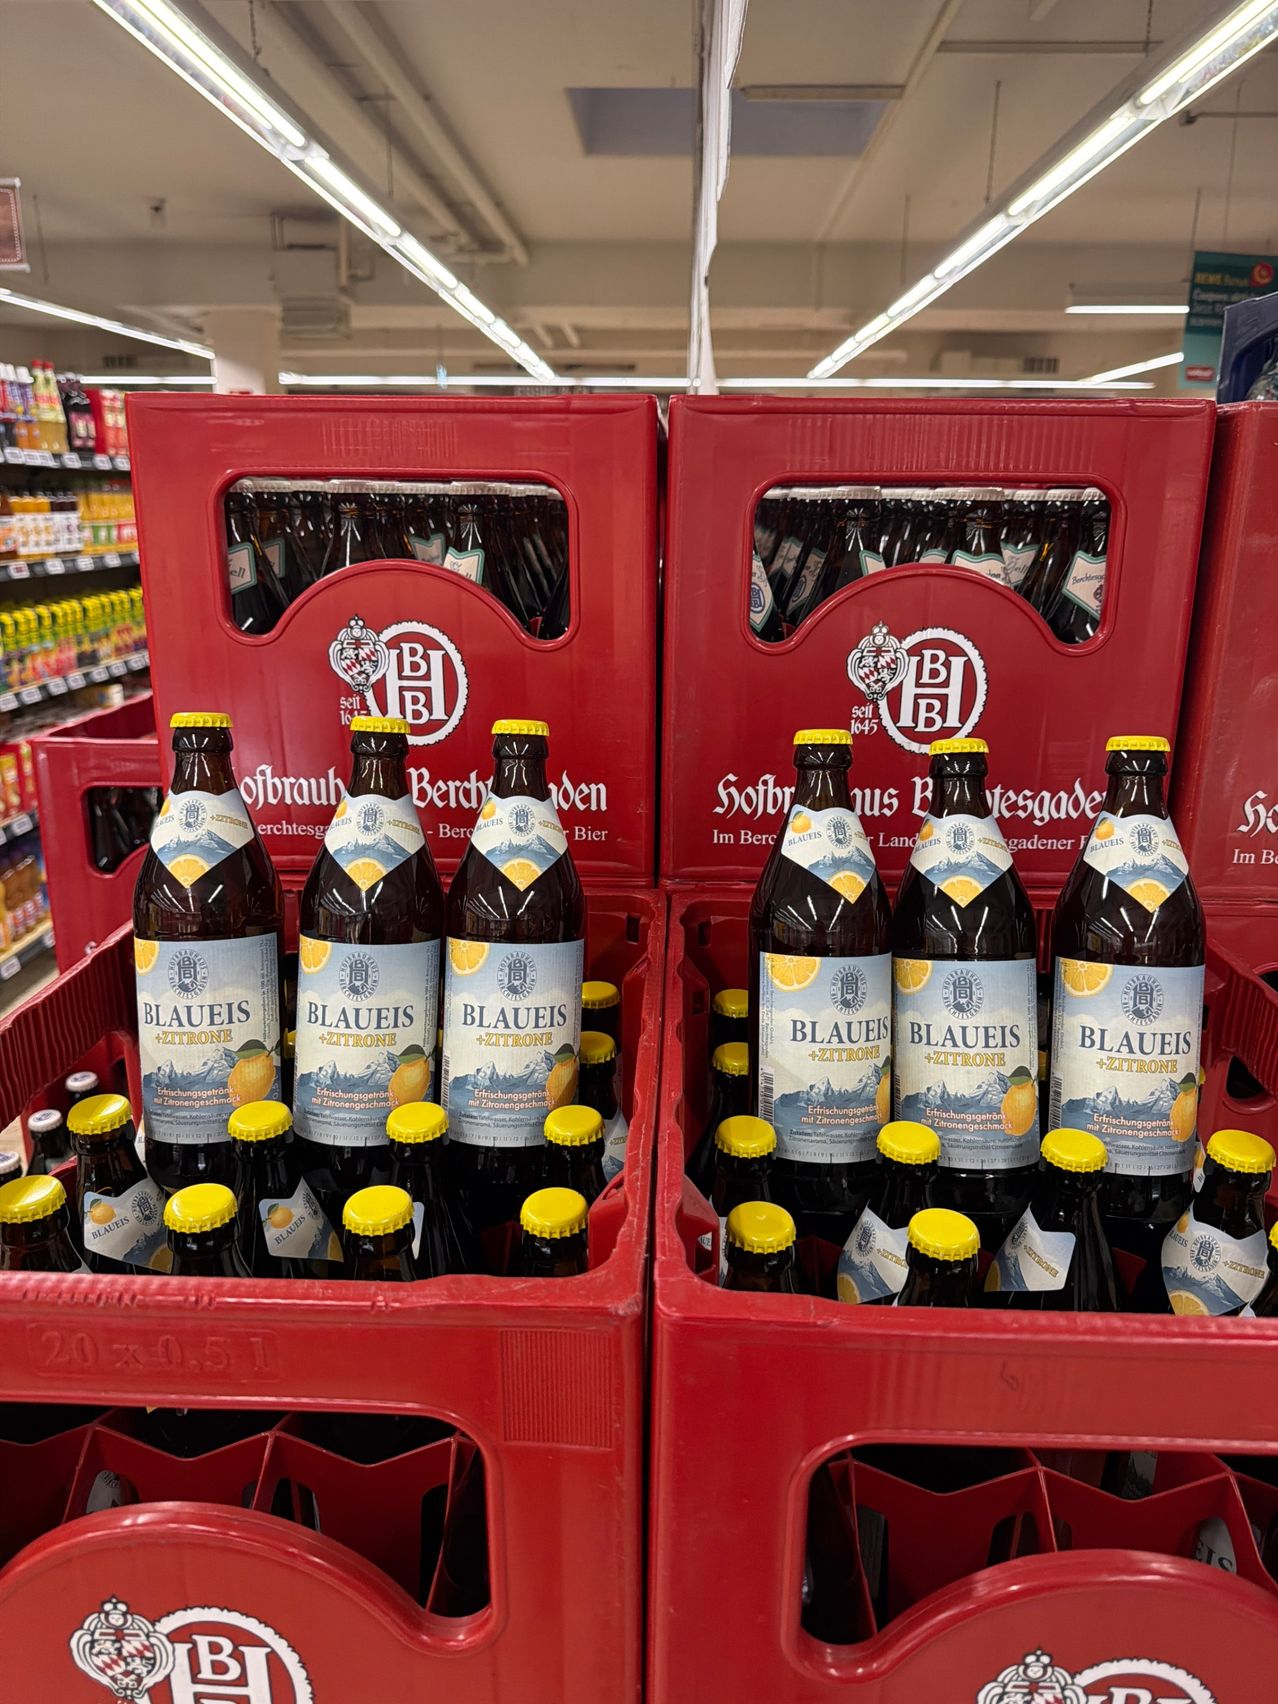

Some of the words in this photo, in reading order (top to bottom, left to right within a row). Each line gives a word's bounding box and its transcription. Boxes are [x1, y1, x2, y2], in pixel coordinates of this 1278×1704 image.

[340, 695, 361, 709] seit
[852, 703, 874, 718] seit
[850, 719, 878, 735] 1645
[239, 764, 347, 809] ofbrauh
[407, 767, 608, 812] Berchden
[574, 826, 609, 841] Bier
[713, 830, 734, 843] Im
[879, 833, 919, 848] Land
[787, 831, 822, 846] BLAUEIS
[1090, 838, 1124, 852] BLAUEIS
[1232, 849, 1255, 864] Im
[144, 1000, 250, 1027] BLAUEIS
[307, 1002, 414, 1030] BLAUEIS
[462, 1003, 567, 1030] BLAUEIS
[155, 1029, 234, 1045] +ZITRONE
[790, 1016, 888, 1044] BLAUEIS
[909, 1022, 1020, 1048] BLAUEIS
[318, 1031, 397, 1048] +ZITRONE
[476, 1032, 554, 1047] +ZITRONE
[1079, 1024, 1191, 1055] BLAUEIS
[808, 1045, 880, 1062] +ZITRONE
[925, 1051, 1006, 1067] +ZITRONE
[1096, 1056, 1178, 1074] +ZITRONE
[157, 1086, 234, 1099] Erfrischungsgetränk
[316, 1087, 394, 1101] Erfrischungsgetränk
[474, 1089, 550, 1101] Erfrischungsgetränk
[163, 1095, 241, 1108] Zitronengeschmack
[312, 1097, 321, 1105] mit
[323, 1098, 400, 1110] Zitronengeschmack
[468, 1099, 479, 1107] mit
[481, 1099, 555, 1110] Zitronengeschmack
[926, 1107, 1006, 1122] Erfrischungsgetränk
[920, 1118, 931, 1126] mit
[934, 1119, 1013, 1132] Zitronengeschmack
[91, 1216, 130, 1239] BLAUEIS
[274, 1215, 306, 1245] BLAUEIS
